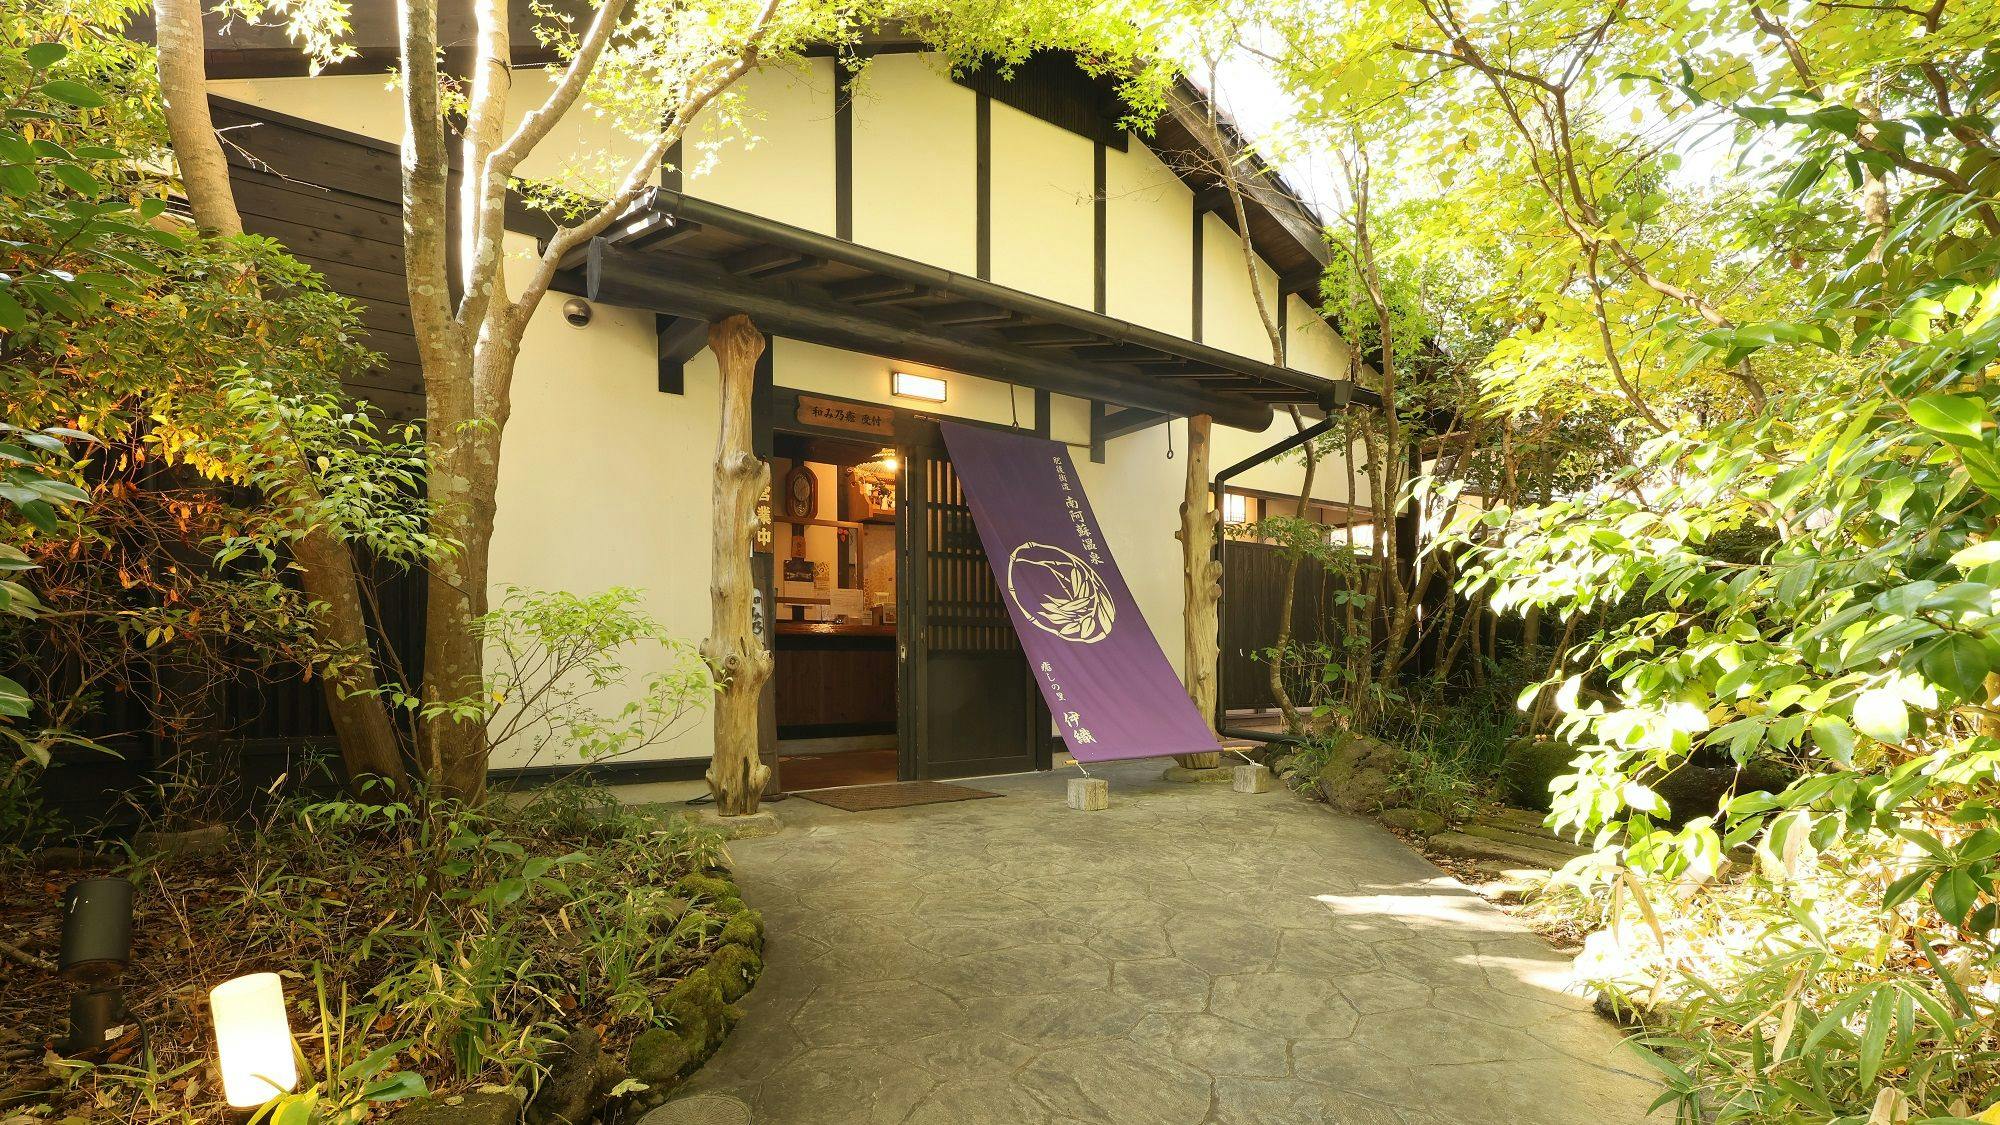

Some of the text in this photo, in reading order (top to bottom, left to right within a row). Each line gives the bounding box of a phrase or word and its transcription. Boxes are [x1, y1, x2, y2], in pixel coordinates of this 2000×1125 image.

[861, 414, 883, 427] 受付
[1064, 495, 1105, 565] 南阿蘇温泉
[1040, 661, 1098, 745] 癒しの里 伊織
